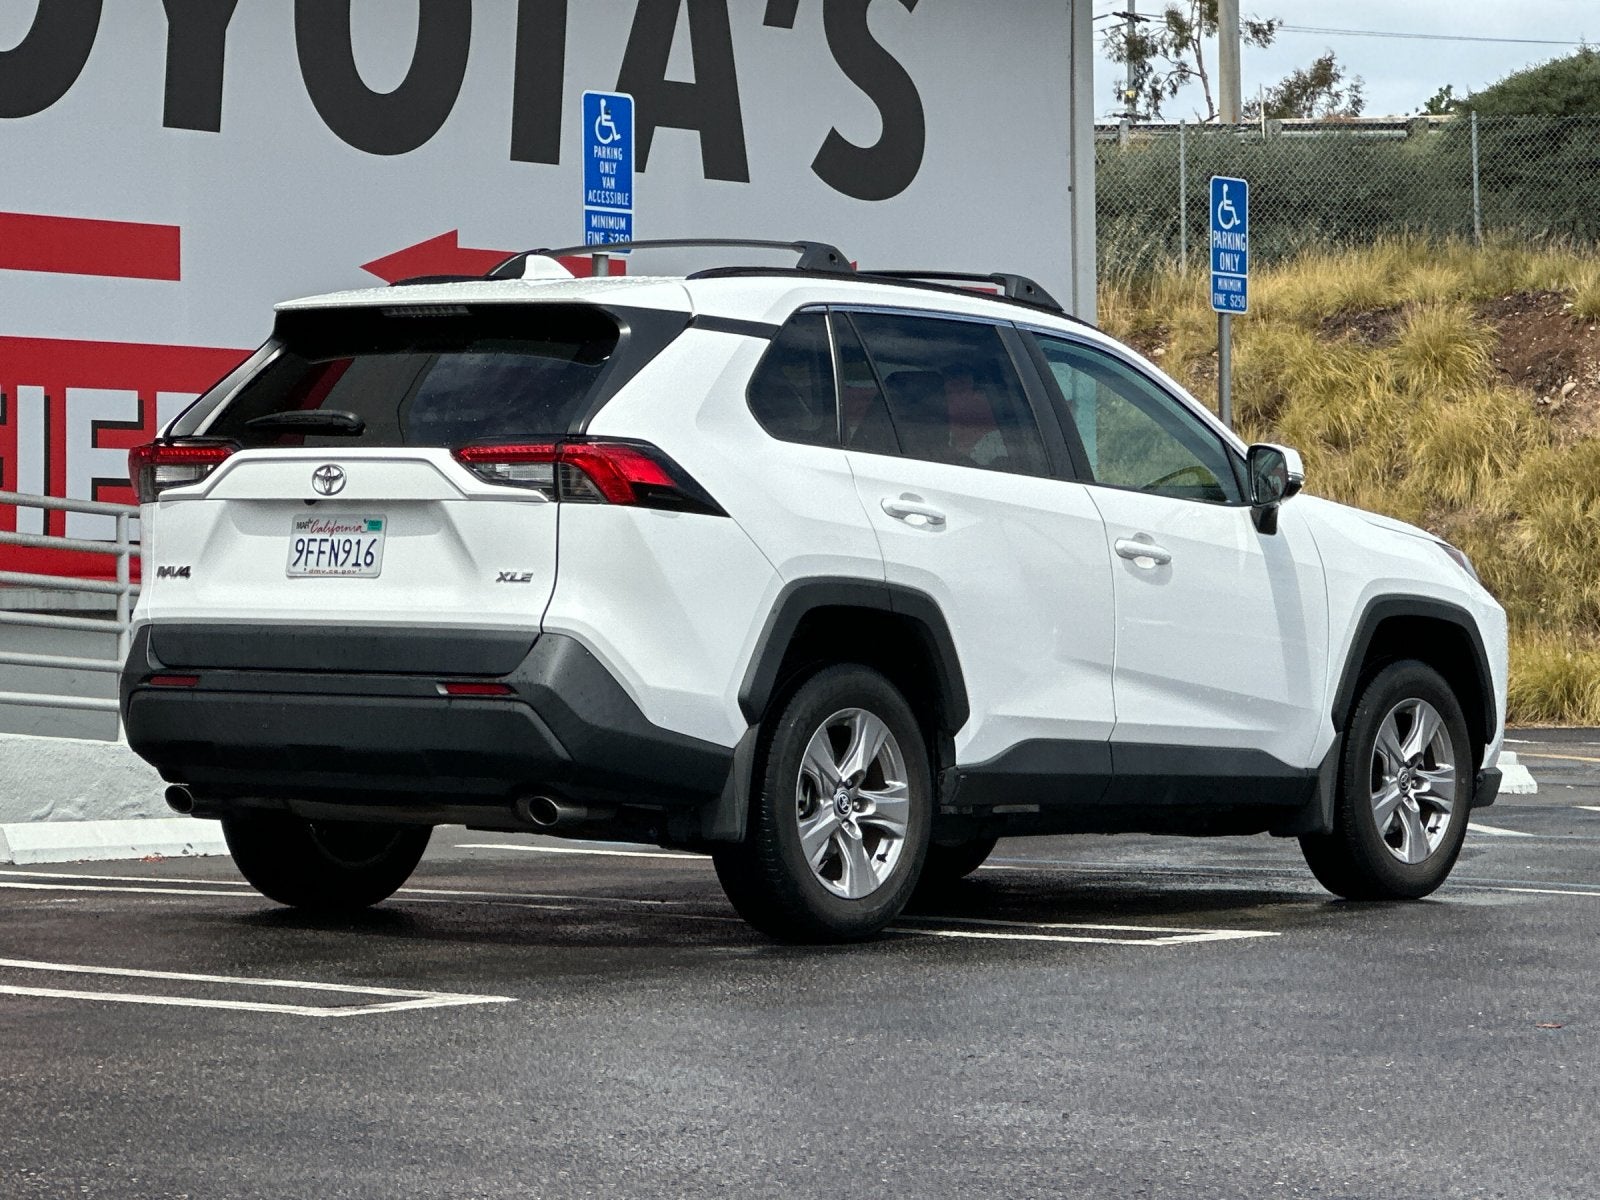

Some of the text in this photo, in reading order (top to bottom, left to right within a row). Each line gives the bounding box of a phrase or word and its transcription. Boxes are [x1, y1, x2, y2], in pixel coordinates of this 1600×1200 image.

[0, 0, 925, 201] YOTAS
[593, 145, 623, 161] PARKING
[599, 161, 617, 175] ONLY
[601, 176, 616, 189] VAN
[587, 189, 630, 206] ACCESSIBLE
[591, 215, 626, 230] MINIMUM
[587, 230, 605, 245] FINE
[1213, 230, 1246, 252] PARKING
[1219, 252, 1240, 272] ONLY
[1217, 278, 1242, 292] MINIMUM
[1213, 293, 1246, 308] FINE $250
[310, 519, 368, 537] California
[292, 538, 377, 568] 9FFN916
[156, 565, 191, 579] RAV4
[495, 571, 534, 583] XLE
